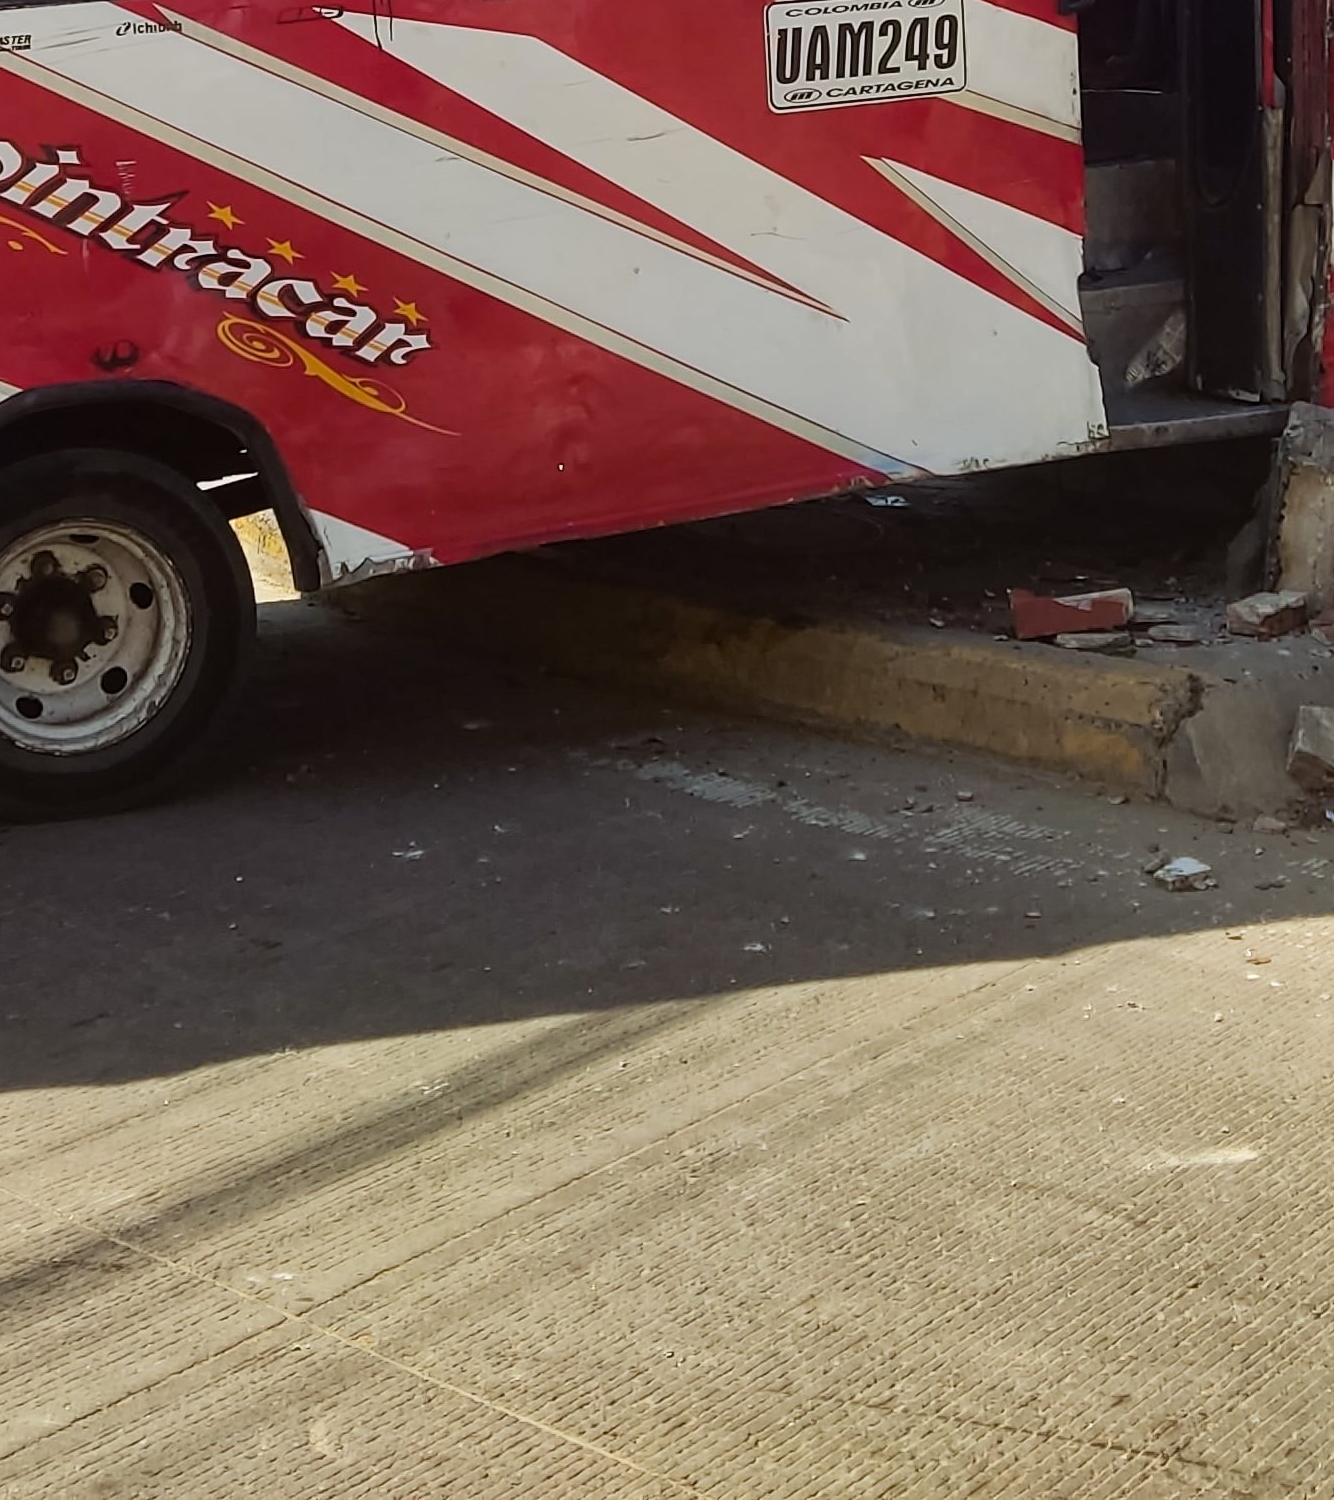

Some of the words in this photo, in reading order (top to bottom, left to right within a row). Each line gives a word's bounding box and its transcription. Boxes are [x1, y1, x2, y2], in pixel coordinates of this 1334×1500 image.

[784, 0, 904, 18] COLOMBIA
[775, 13, 959, 85] UAM249
[825, 77, 956, 98] CARTAGENA
